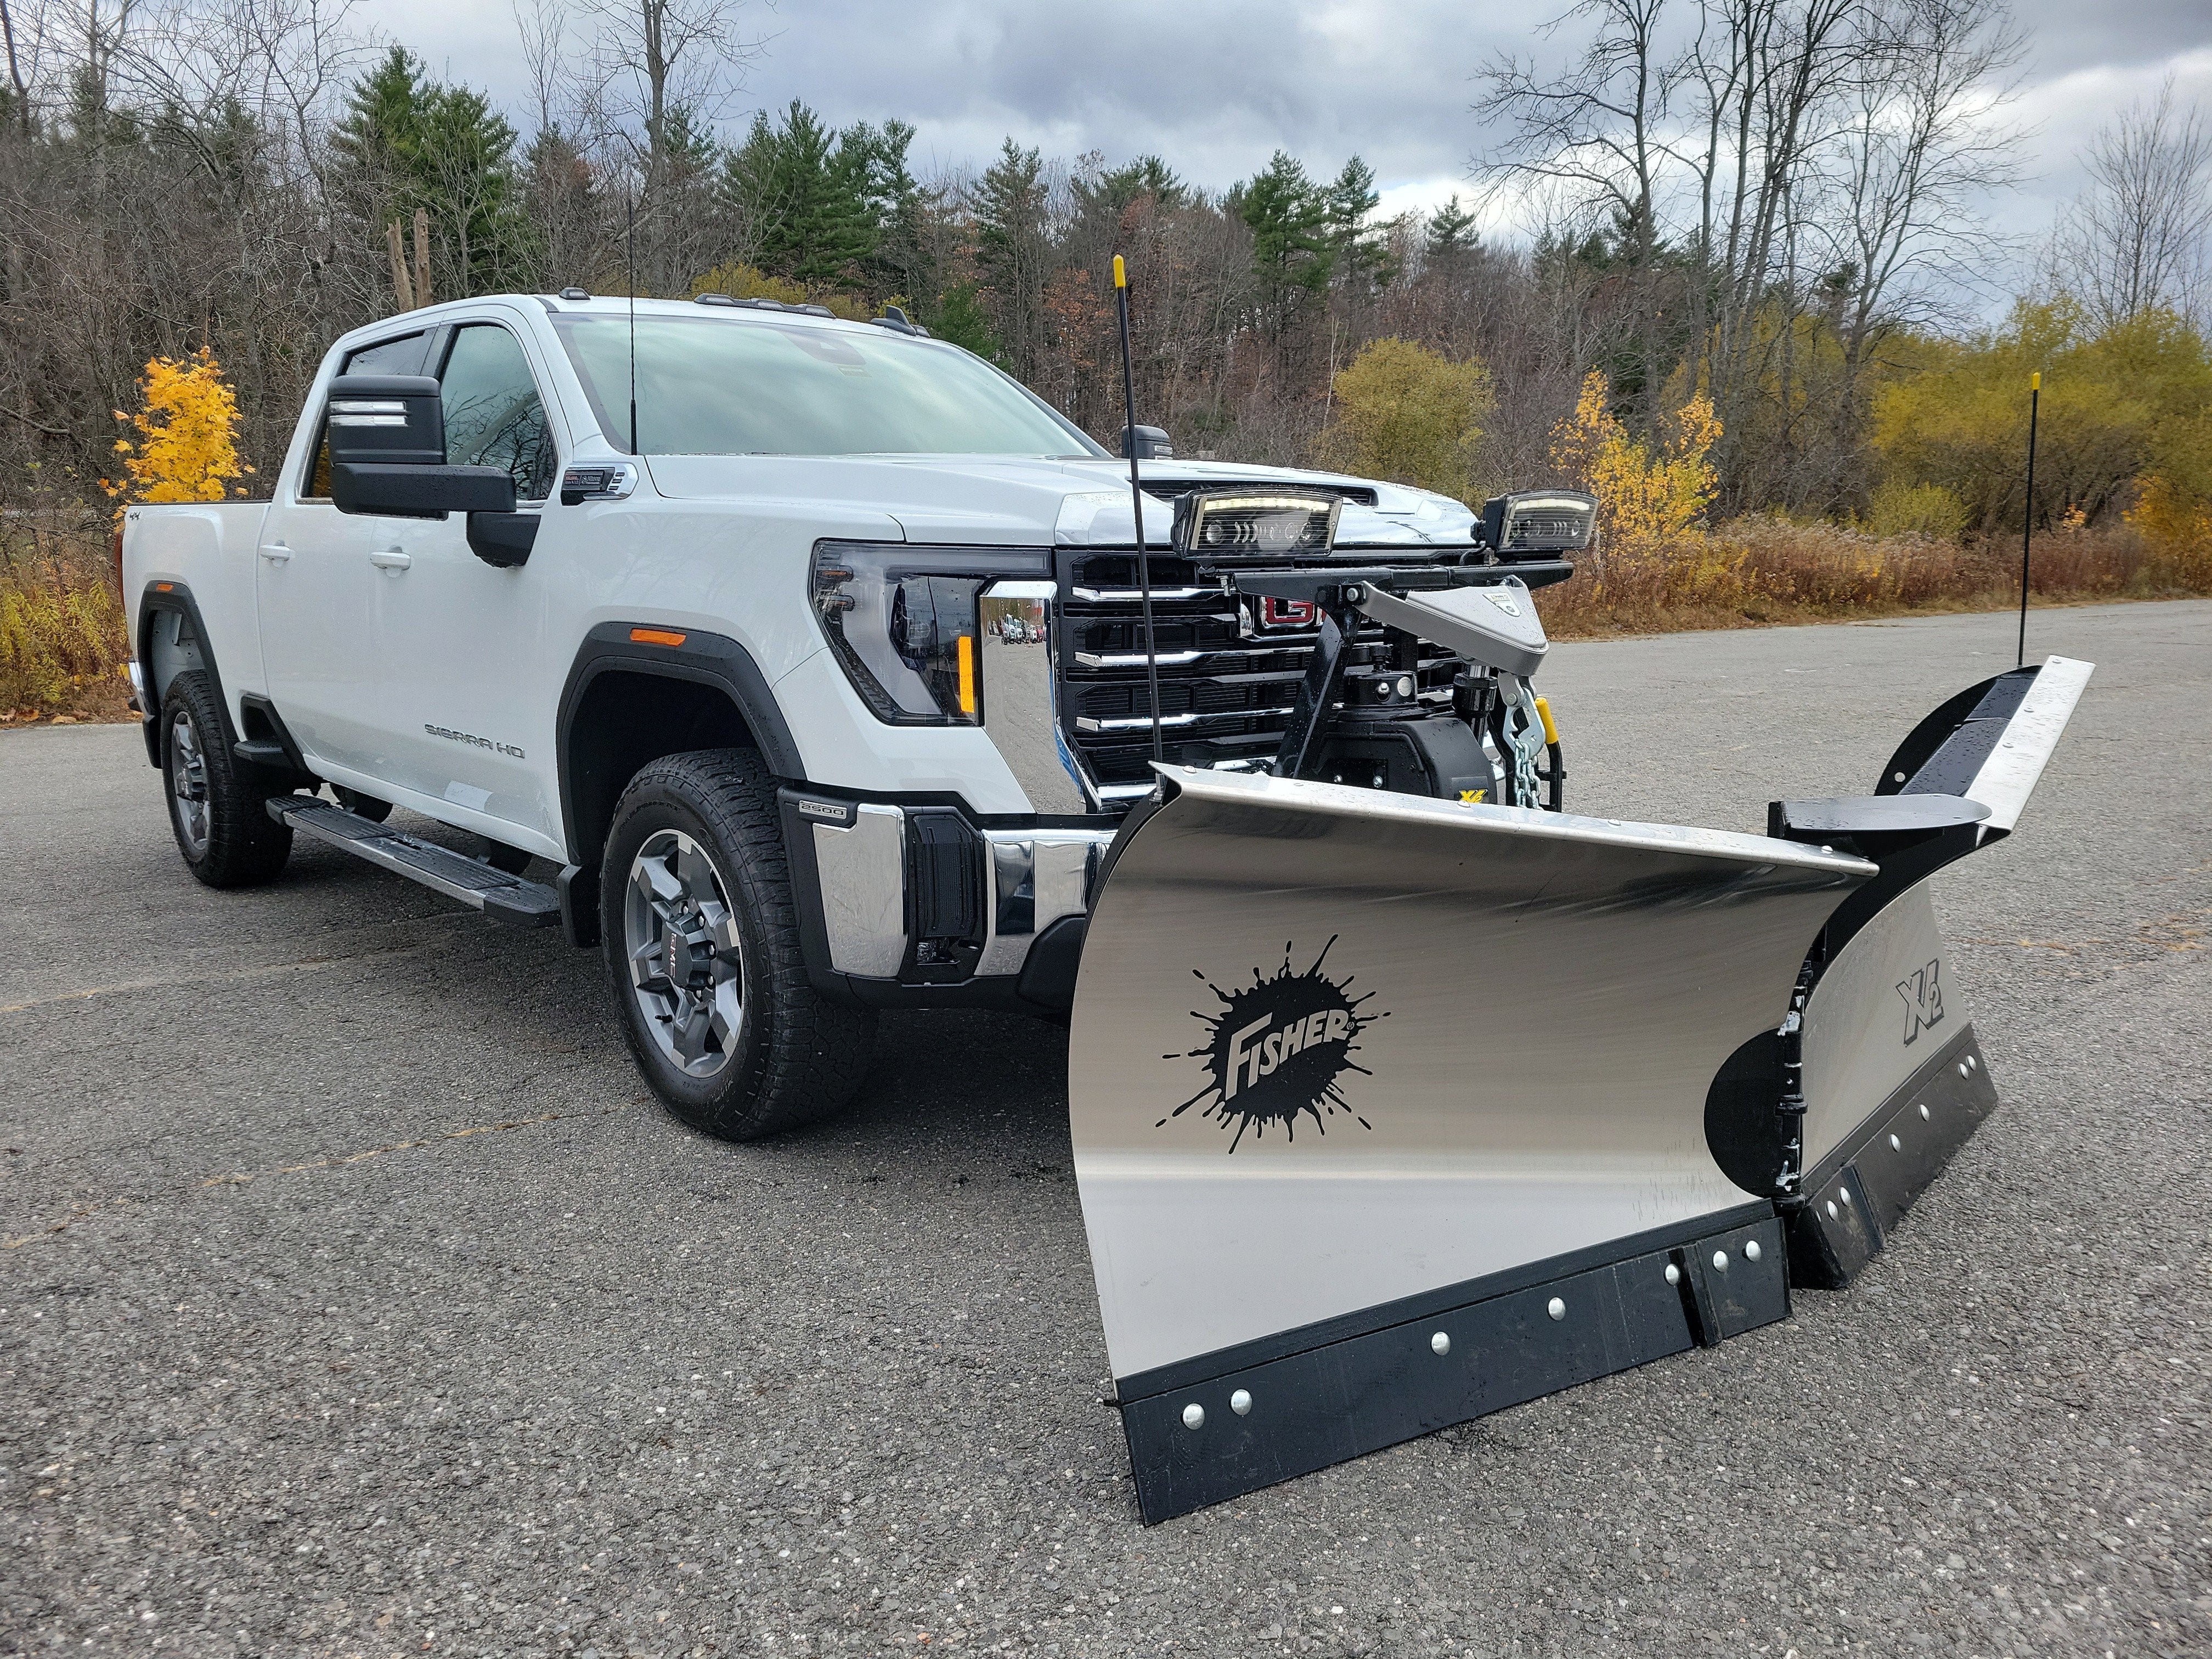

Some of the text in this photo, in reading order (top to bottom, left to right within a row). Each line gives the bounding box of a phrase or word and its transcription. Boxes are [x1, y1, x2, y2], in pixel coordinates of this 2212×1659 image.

[425, 723, 525, 759] SIERRA HD
[801, 803, 844, 816] 2500
